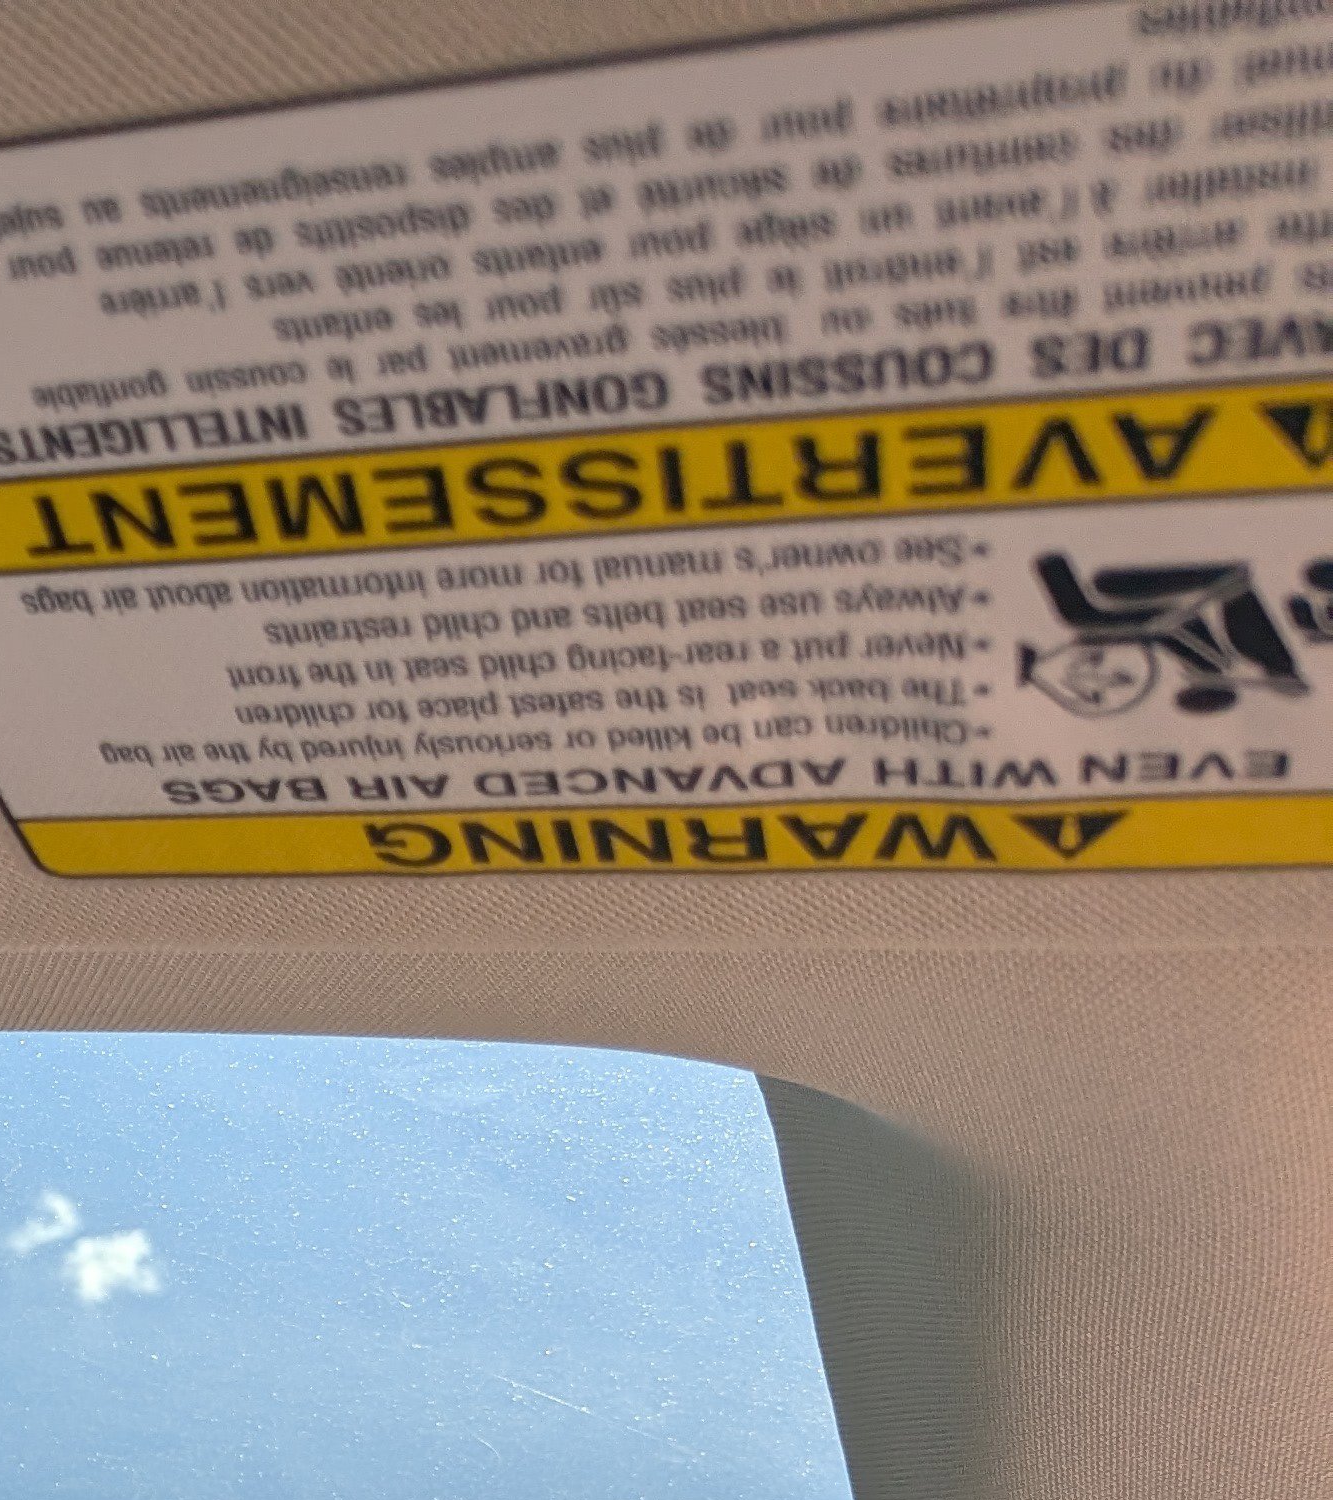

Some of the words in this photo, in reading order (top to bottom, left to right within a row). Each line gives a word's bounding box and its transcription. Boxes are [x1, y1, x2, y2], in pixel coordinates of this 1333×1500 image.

[82, 194, 122, 226] au
[6, 244, 77, 280] pour
[96, 233, 215, 270] retenue
[243, 270, 315, 302] vers
[334, 254, 450, 297] orienté
[272, 305, 394, 347] enfants
[1029, 327, 1149, 380] DES
[183, 361, 307, 400] coussin
[700, 342, 994, 407] COUSSINS
[29, 367, 168, 415] gonflable
[333, 371, 669, 438] GONFLABLES
[25, 407, 1216, 558] AVERTISSEMENT
[733, 541, 883, 577] owner's
[895, 535, 964, 567] See
[436, 563, 524, 594] more
[535, 560, 583, 589] for
[593, 550, 723, 586] manual
[18, 587, 93, 617] bags
[101, 588, 137, 616] air
[145, 582, 230, 613] about
[239, 570, 425, 608] information
[760, 592, 821, 616] use
[834, 583, 964, 617] Always
[511, 606, 571, 637] and
[582, 601, 666, 632] belts
[677, 596, 746, 627] seat
[263, 616, 412, 649] restraints
[424, 613, 500, 642] child
[566, 641, 748, 674] rear-facing
[760, 639, 781, 660] a
[792, 631, 850, 665] put
[864, 632, 965, 663] Never
[224, 665, 301, 691] front
[308, 662, 357, 687] the
[364, 660, 394, 685] in
[402, 656, 468, 684] seat
[480, 652, 556, 680] child
[417, 692, 498, 722] place
[509, 692, 604, 719] safest
[615, 687, 668, 713] the
[677, 685, 704, 712] is
[727, 680, 798, 708] seat
[810, 679, 888, 708] back
[901, 679, 966, 707] The
[234, 702, 355, 729] children
[366, 701, 410, 725] for
[565, 729, 596, 752] or
[606, 726, 692, 753] killed
[702, 723, 742, 749] be
[754, 716, 813, 741] can
[824, 714, 970, 748] Children
[98, 742, 153, 768] bag
[161, 744, 194, 766] air
[203, 742, 249, 766] the
[256, 737, 295, 764] by
[301, 734, 404, 763] injured
[414, 733, 552, 759] seriously
[474, 759, 846, 798] ADVANCED
[874, 758, 1058, 788] WITH
[1082, 751, 1289, 785] EVEN
[160, 777, 327, 805] BAGS
[345, 774, 449, 801] AIR
[363, 813, 997, 868] WARNING
